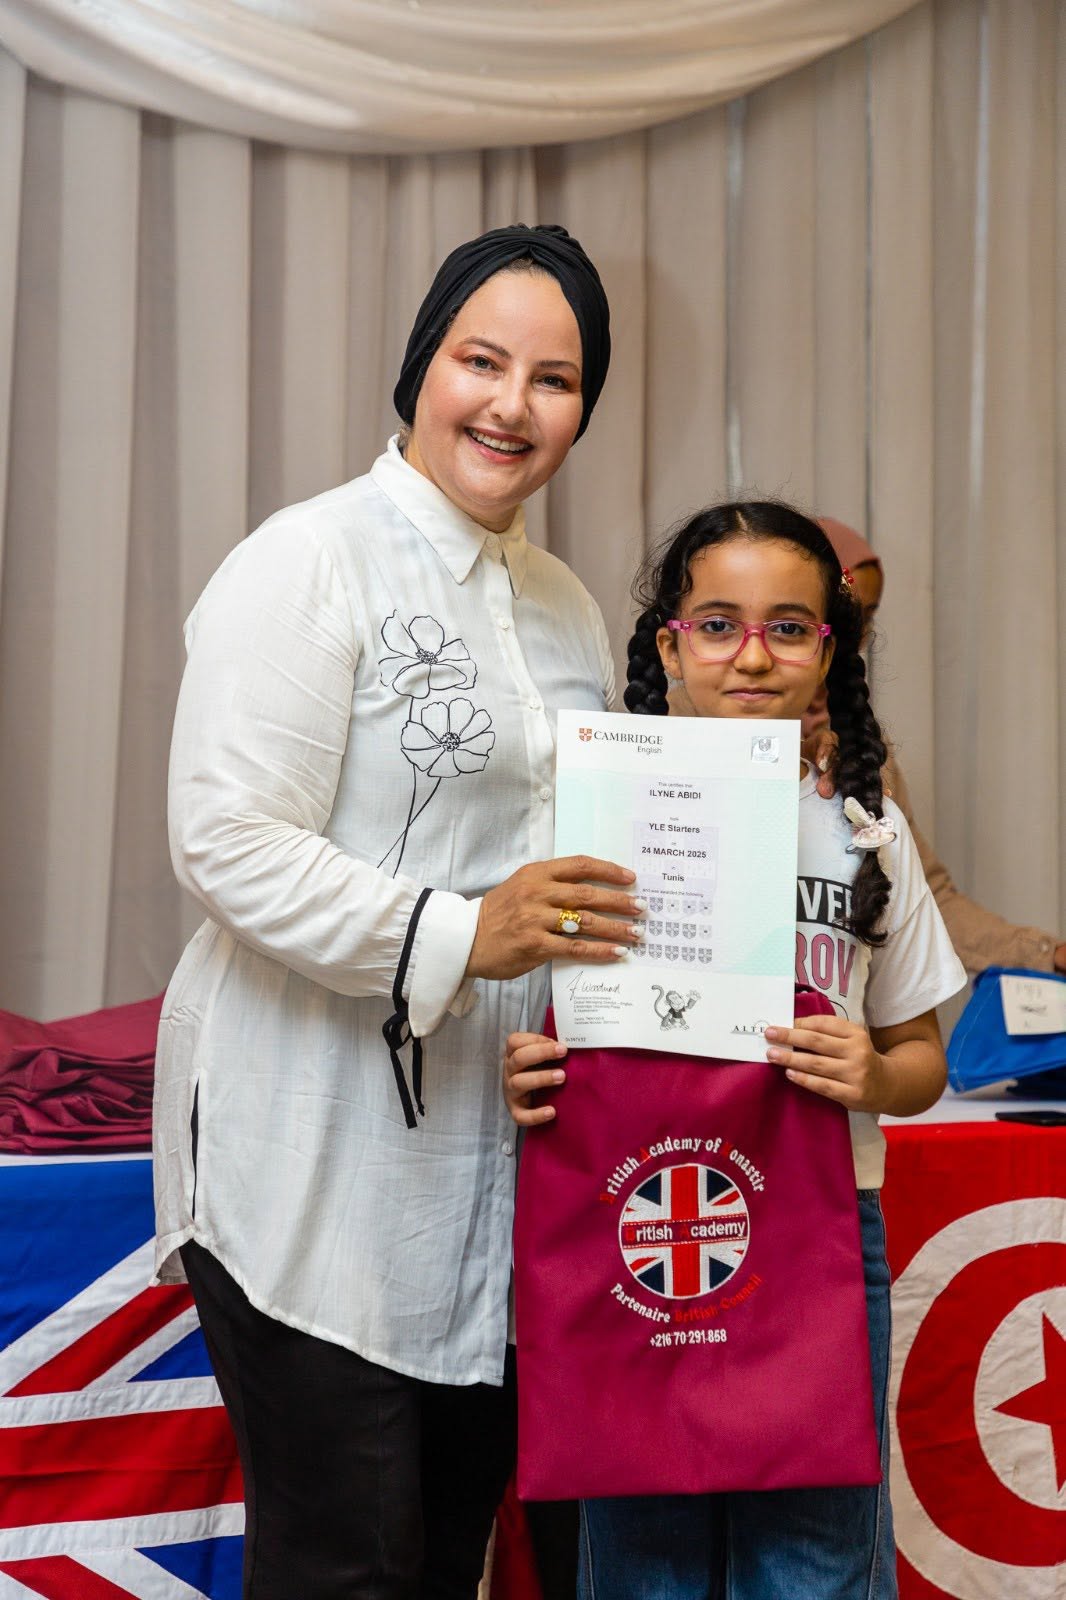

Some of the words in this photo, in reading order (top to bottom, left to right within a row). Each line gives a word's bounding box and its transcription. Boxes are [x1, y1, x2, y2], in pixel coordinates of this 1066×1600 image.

[593, 730, 663, 745] CAMBRIDGE
[637, 745, 662, 755] English
[649, 789, 675, 798] ILYNE
[677, 791, 701, 799] ABIDI
[649, 822, 666, 831] YLE
[667, 824, 700, 834] Starters
[641, 846, 651, 854] 24
[653, 847, 685, 857] MARCH
[687, 850, 707, 858] 2025
[662, 872, 685, 882] Tunis
[600, 1156, 641, 1205] British
[639, 1136, 701, 1165] Academy
[704, 1137, 723, 1153] of
[722, 1141, 766, 1193] Monastir
[625, 1224, 673, 1242] British
[680, 1220, 746, 1240] Academy
[610, 1282, 671, 1324] Partenaire
[675, 1305, 719, 1323] British
[720, 1274, 763, 1310] Council
[650, 1333, 672, 1348] +216
[674, 1332, 686, 1346] 70
[688, 1330, 706, 1345] 291
